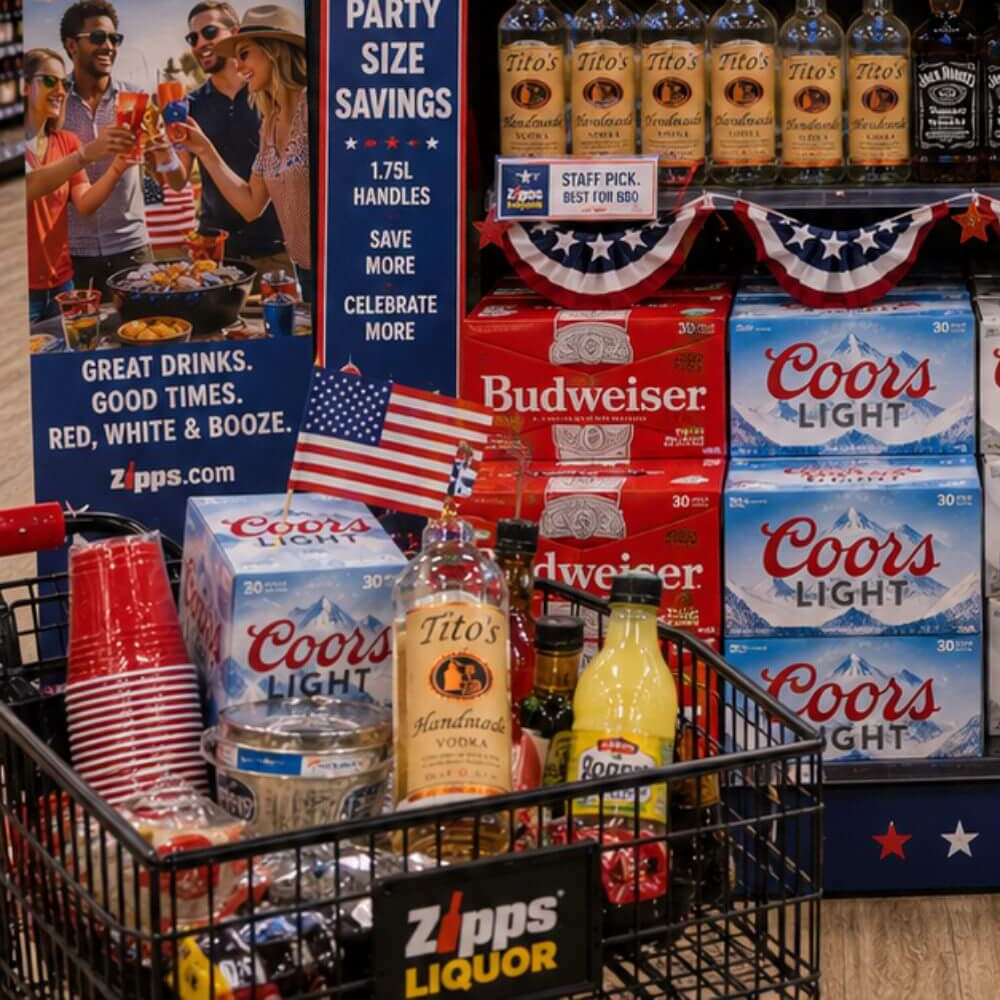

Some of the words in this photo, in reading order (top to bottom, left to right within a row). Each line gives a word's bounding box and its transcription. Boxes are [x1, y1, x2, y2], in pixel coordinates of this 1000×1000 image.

[361, 42, 425, 75] SIZE
[335, 88, 452, 120] SAVINGS
[370, 161, 413, 180] 1.75L
[562, 172, 602, 187] STAFF
[354, 187, 431, 206] HANDLES
[370, 230, 412, 249] SAVE
[366, 256, 415, 275] MORE
[344, 295, 437, 315] CELEBRATE
[365, 321, 415, 341] MORE
[933, 322, 949, 334] 30
[82, 355, 153, 382] GREAT
[161, 350, 253, 377] DRINKS.
[765, 343, 937, 399] Coors
[92, 388, 157, 414] GOOD
[165, 382, 243, 408] TIMES.
[481, 375, 707, 412] Budweiser
[799, 403, 905, 428] LIGHT
[49, 425, 98, 450] RED,
[104, 418, 177, 446] WHITE
[184, 417, 201, 440] &
[208, 411, 292, 438] BOOZE.
[673, 496, 690, 508] 30
[937, 494, 955, 507] 30
[221, 515, 372, 537] Coors
[257, 534, 358, 548] LIGHT
[761, 517, 941, 578] Coors
[361, 574, 384, 590] 30
[797, 581, 908, 607] LIGHT
[420, 611, 501, 645] Tito's
[247, 618, 393, 673] Coors
[937, 640, 954, 652] 30
[267, 668, 371, 698] LIGHT
[761, 663, 941, 722] Coors
[820, 725, 908, 750] IGHT
[405, 890, 560, 958] Zipps
[404, 940, 557, 999] LIQUOR
